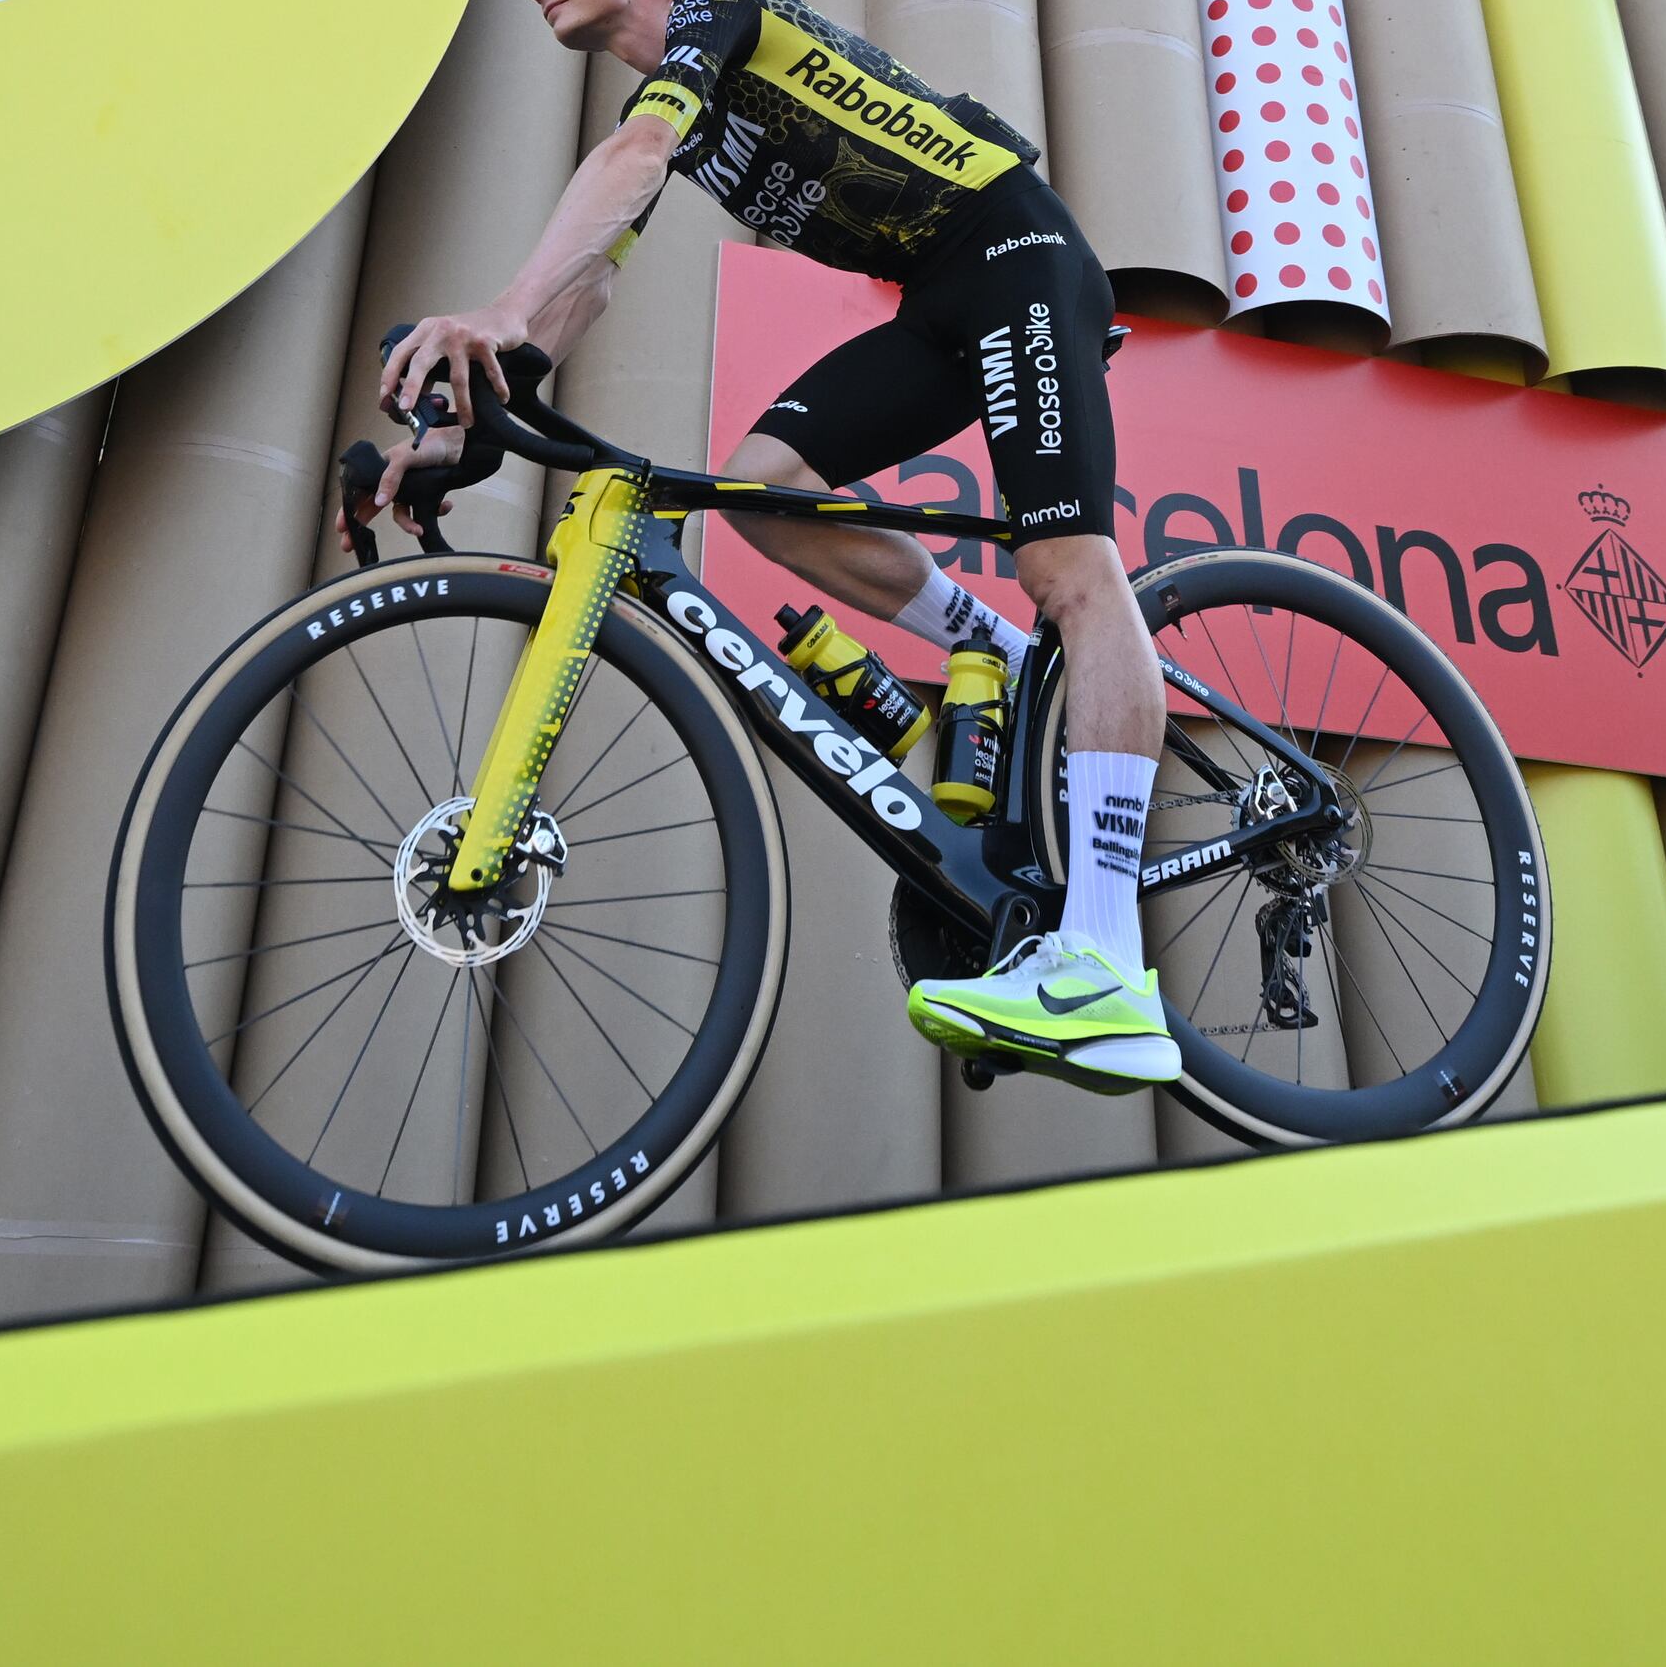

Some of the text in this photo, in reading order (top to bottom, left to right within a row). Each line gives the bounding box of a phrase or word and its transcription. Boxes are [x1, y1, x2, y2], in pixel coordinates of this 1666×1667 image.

[785, 48, 978, 172] Rabobank
[687, 111, 766, 203] VISMA
[986, 231, 1067, 261] Rabobank
[980, 326, 1018, 440] VISMA
[1036, 377, 1062, 454] lease
[1022, 499, 1081, 527] nimbl
[307, 579, 449, 640] RESERVE
[667, 591, 922, 830] cervélo
[1142, 840, 1233, 887] SRAM
[1515, 850, 1536, 987] RESERVE
[496, 1150, 649, 1243] RESERVE
